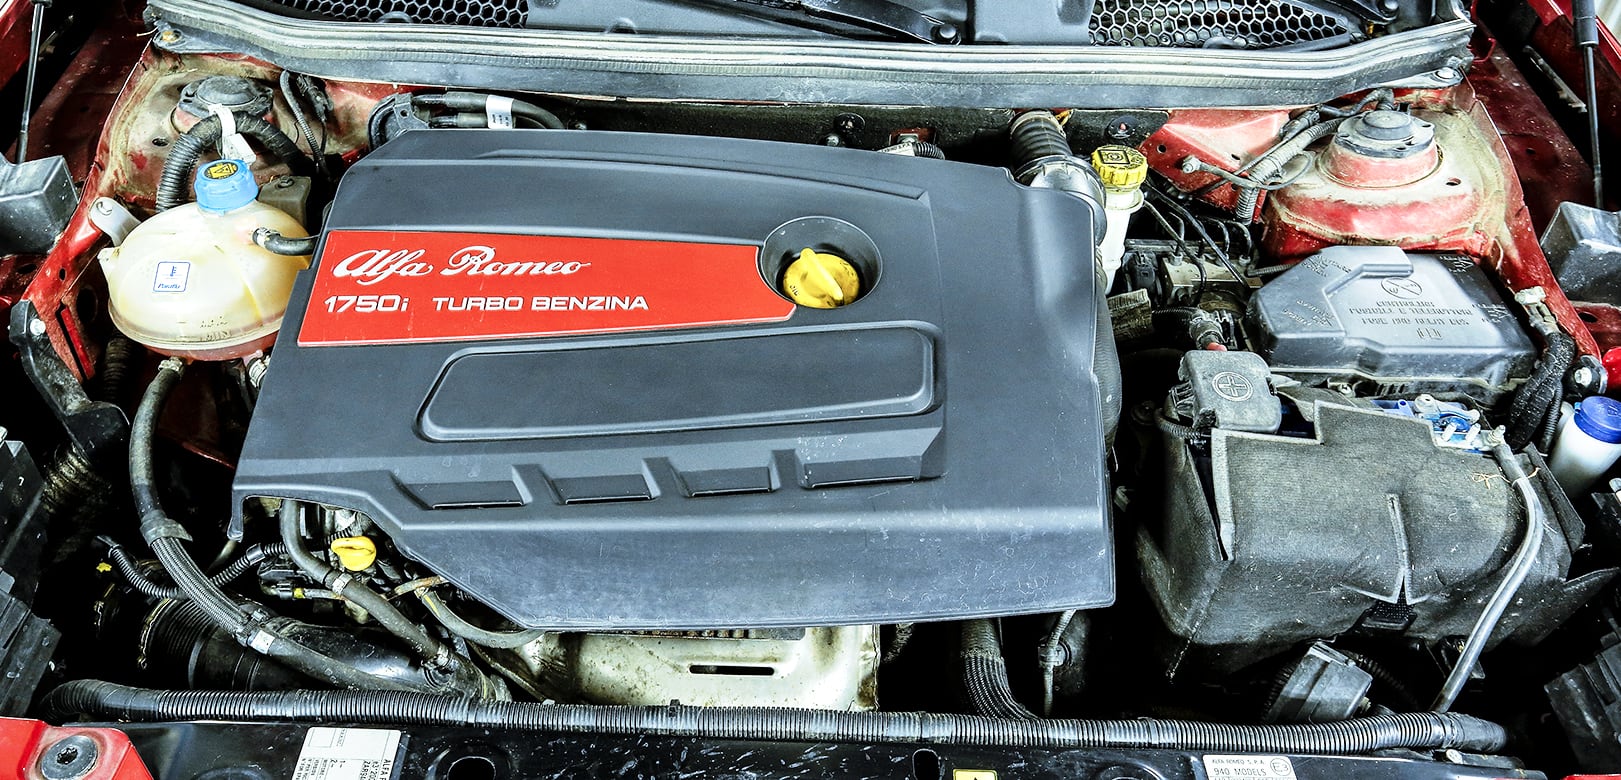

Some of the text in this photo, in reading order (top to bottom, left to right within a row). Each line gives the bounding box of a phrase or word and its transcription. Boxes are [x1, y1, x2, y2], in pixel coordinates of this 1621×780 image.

[333, 245, 592, 286] Alfa Romeo
[324, 294, 649, 313] 1750i TURBO BENZINA
[1213, 767, 1267, 776] 940 MODELS
